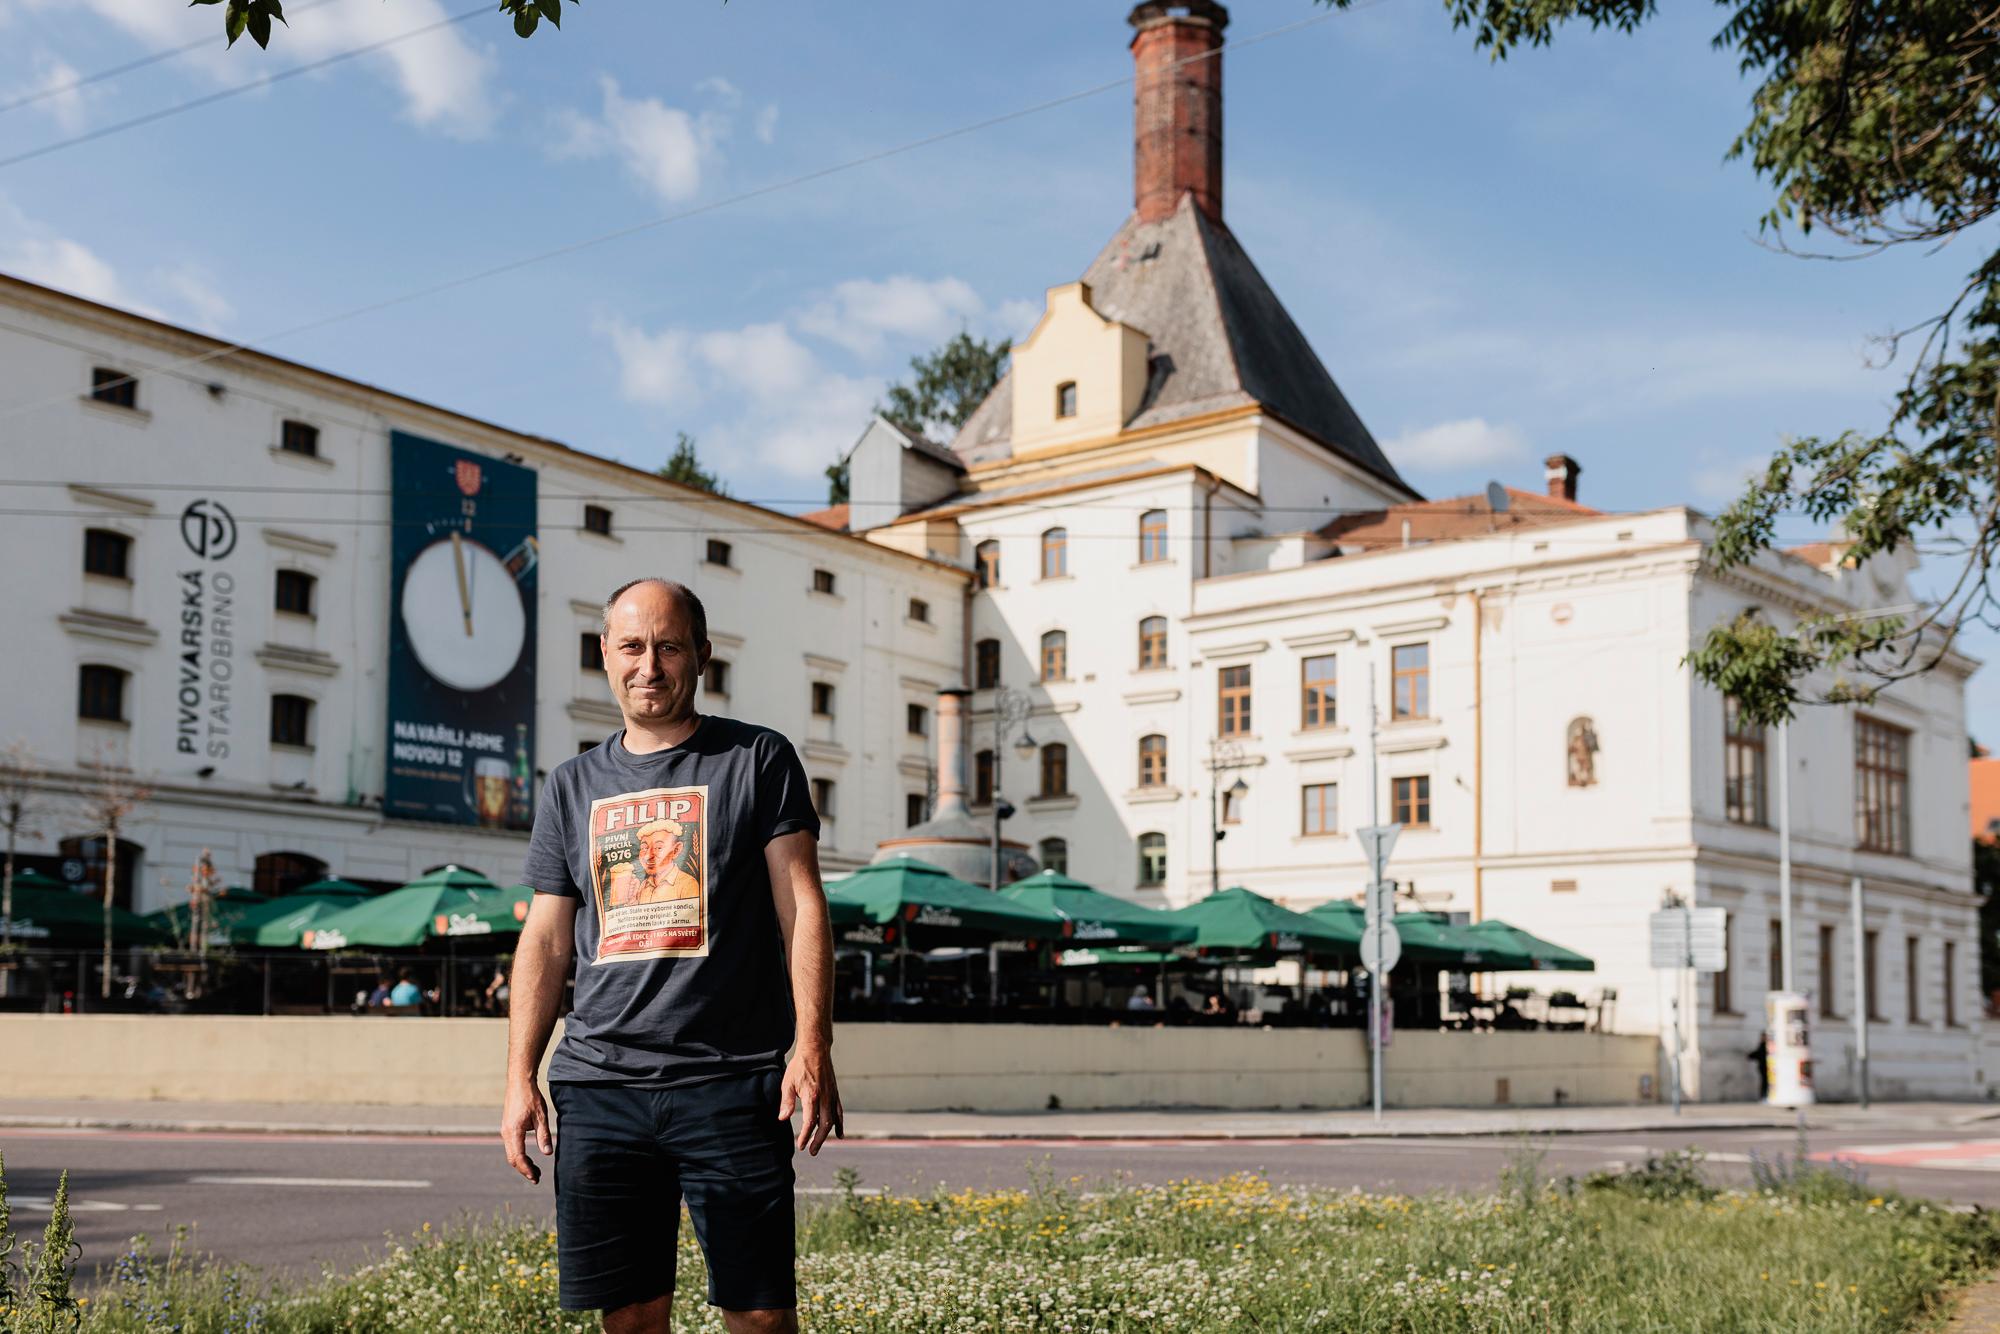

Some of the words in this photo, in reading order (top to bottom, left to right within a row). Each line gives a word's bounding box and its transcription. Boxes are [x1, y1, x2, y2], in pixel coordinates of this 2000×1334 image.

[177, 569, 203, 755] PIVOVARSKÁ
[206, 571, 236, 760] STAROBRNO
[394, 721, 464, 747] NAVAŘILI
[465, 731, 504, 753] JSME
[393, 743, 446, 765] NOVOU
[447, 749, 463, 768] 12
[605, 800, 691, 831] FILIP
[605, 849, 632, 862] 1976
